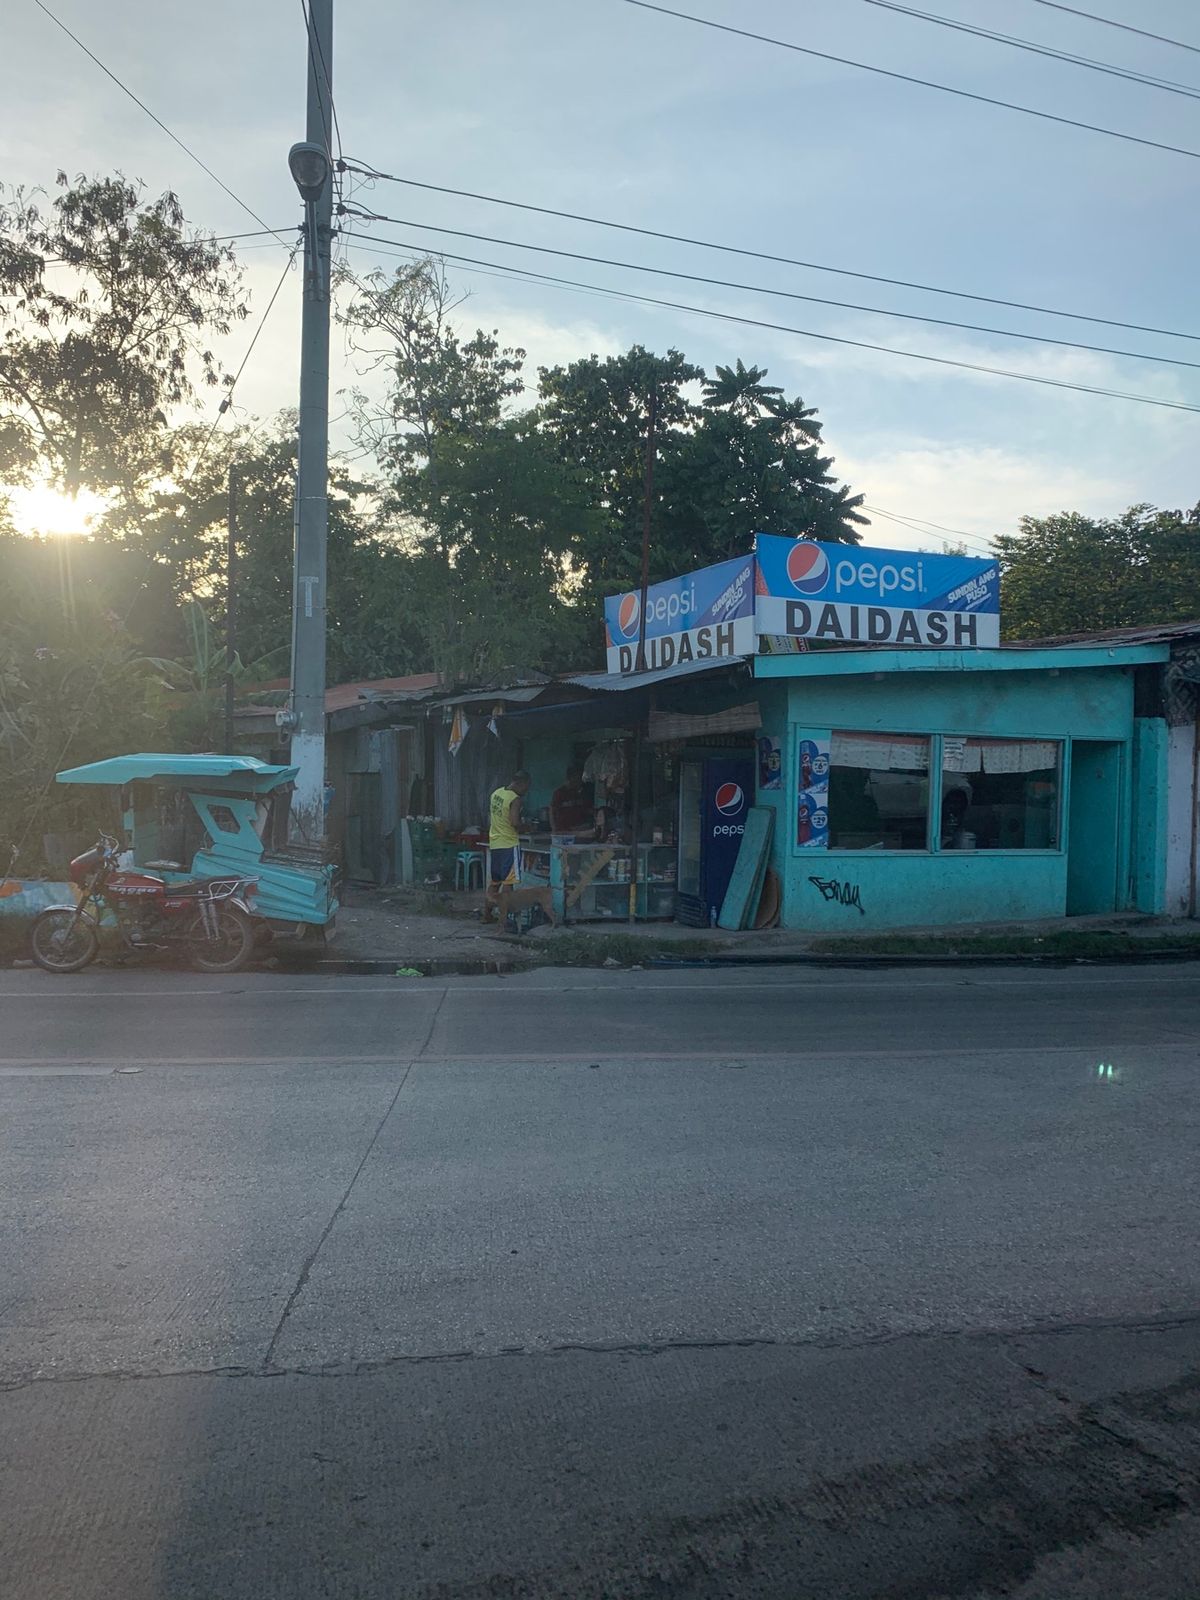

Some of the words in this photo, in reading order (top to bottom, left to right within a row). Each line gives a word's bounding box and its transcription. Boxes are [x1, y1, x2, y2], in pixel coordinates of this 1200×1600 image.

[835, 561, 923, 598] pepsi
[947, 579, 978, 604] SUNDIN
[978, 569, 996, 587] ANG
[966, 584, 988, 603] PUSO
[785, 599, 978, 646] DAIDASH
[713, 824, 745, 838] peps
